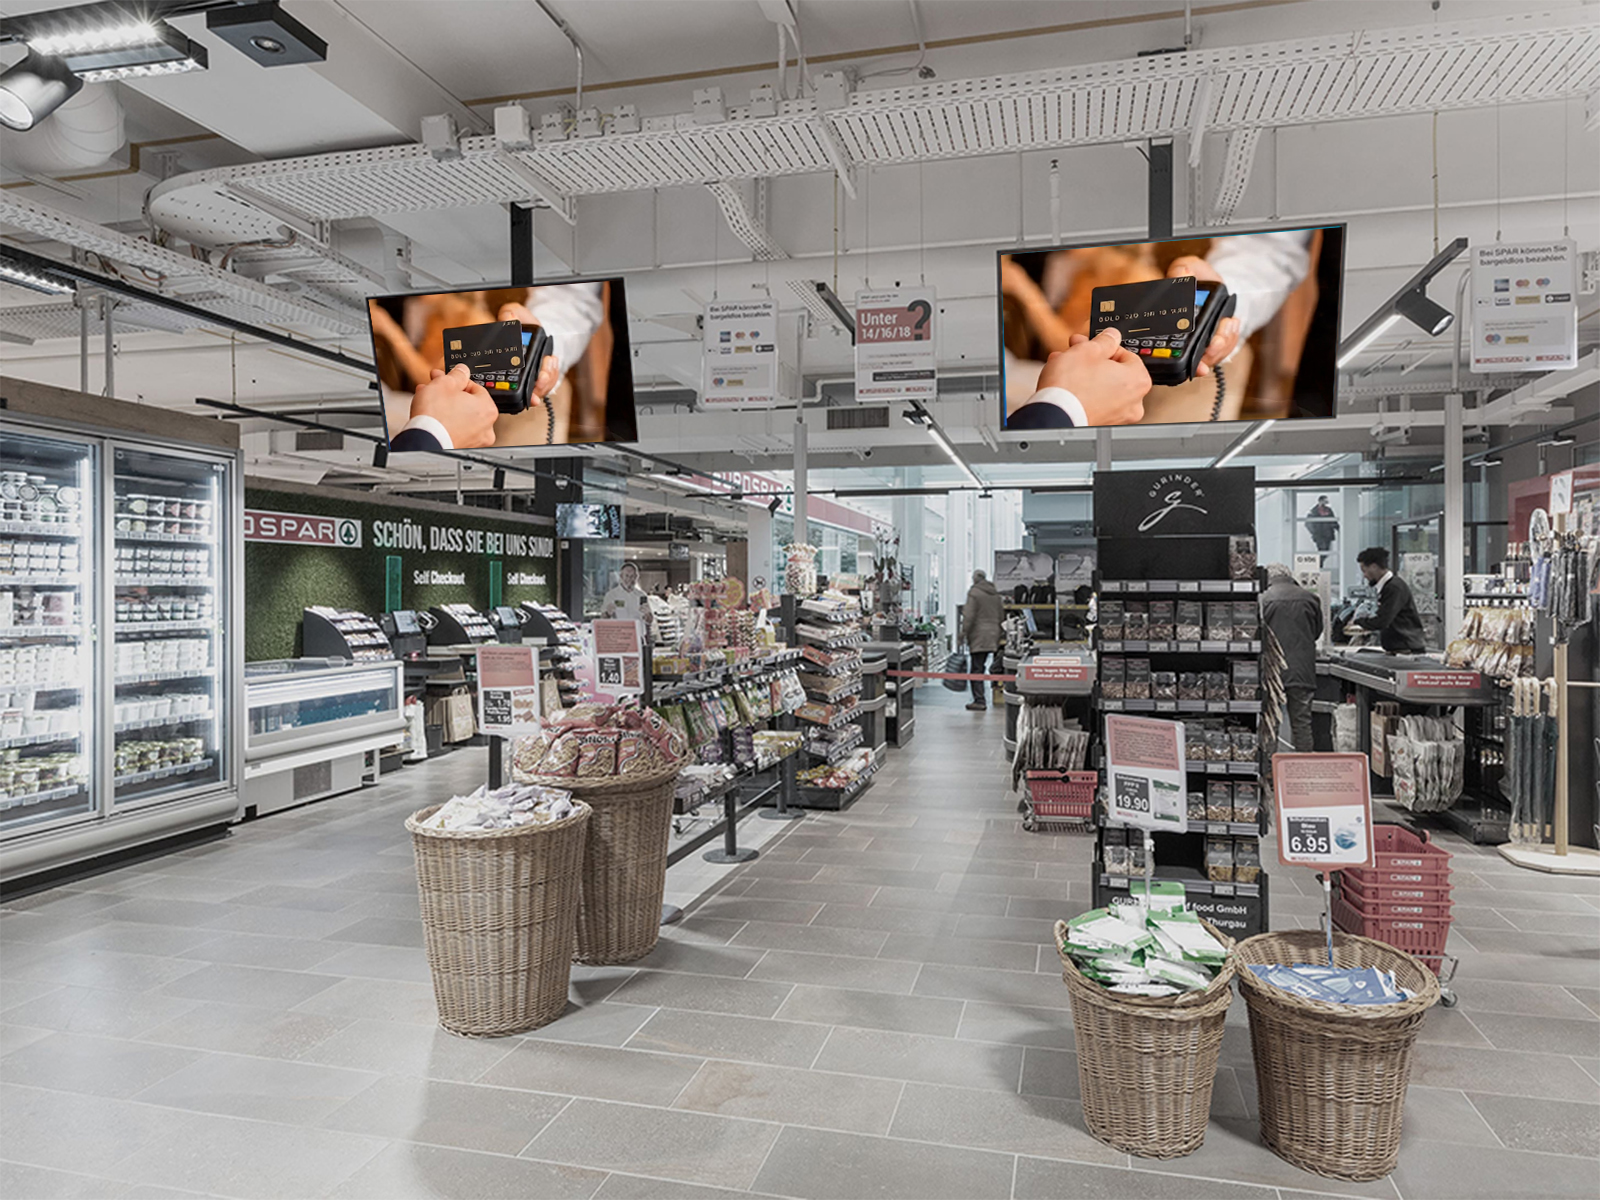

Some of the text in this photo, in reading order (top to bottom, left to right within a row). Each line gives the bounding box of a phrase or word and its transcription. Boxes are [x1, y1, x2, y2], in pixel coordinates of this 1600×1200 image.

[1495, 248, 1518, 256] SPAR
[1520, 246, 1552, 255] können
[861, 312, 898, 326] Unter
[907, 299, 932, 341] ?
[862, 326, 911, 339] 14/16/18
[1149, 474, 1204, 498] GURINDER
[373, 518, 554, 559] SCHÖN, DASS SIE BEI UNS SIND!
[413, 570, 466, 586] Self Checkout
[507, 572, 546, 586] Self Checkout
[1117, 794, 1149, 811] 19.90
[1291, 836, 1328, 853] 6.95
[1193, 903, 1215, 912] food
[1216, 904, 1248, 915] GmbH
[1206, 916, 1247, 929] Thurgau
